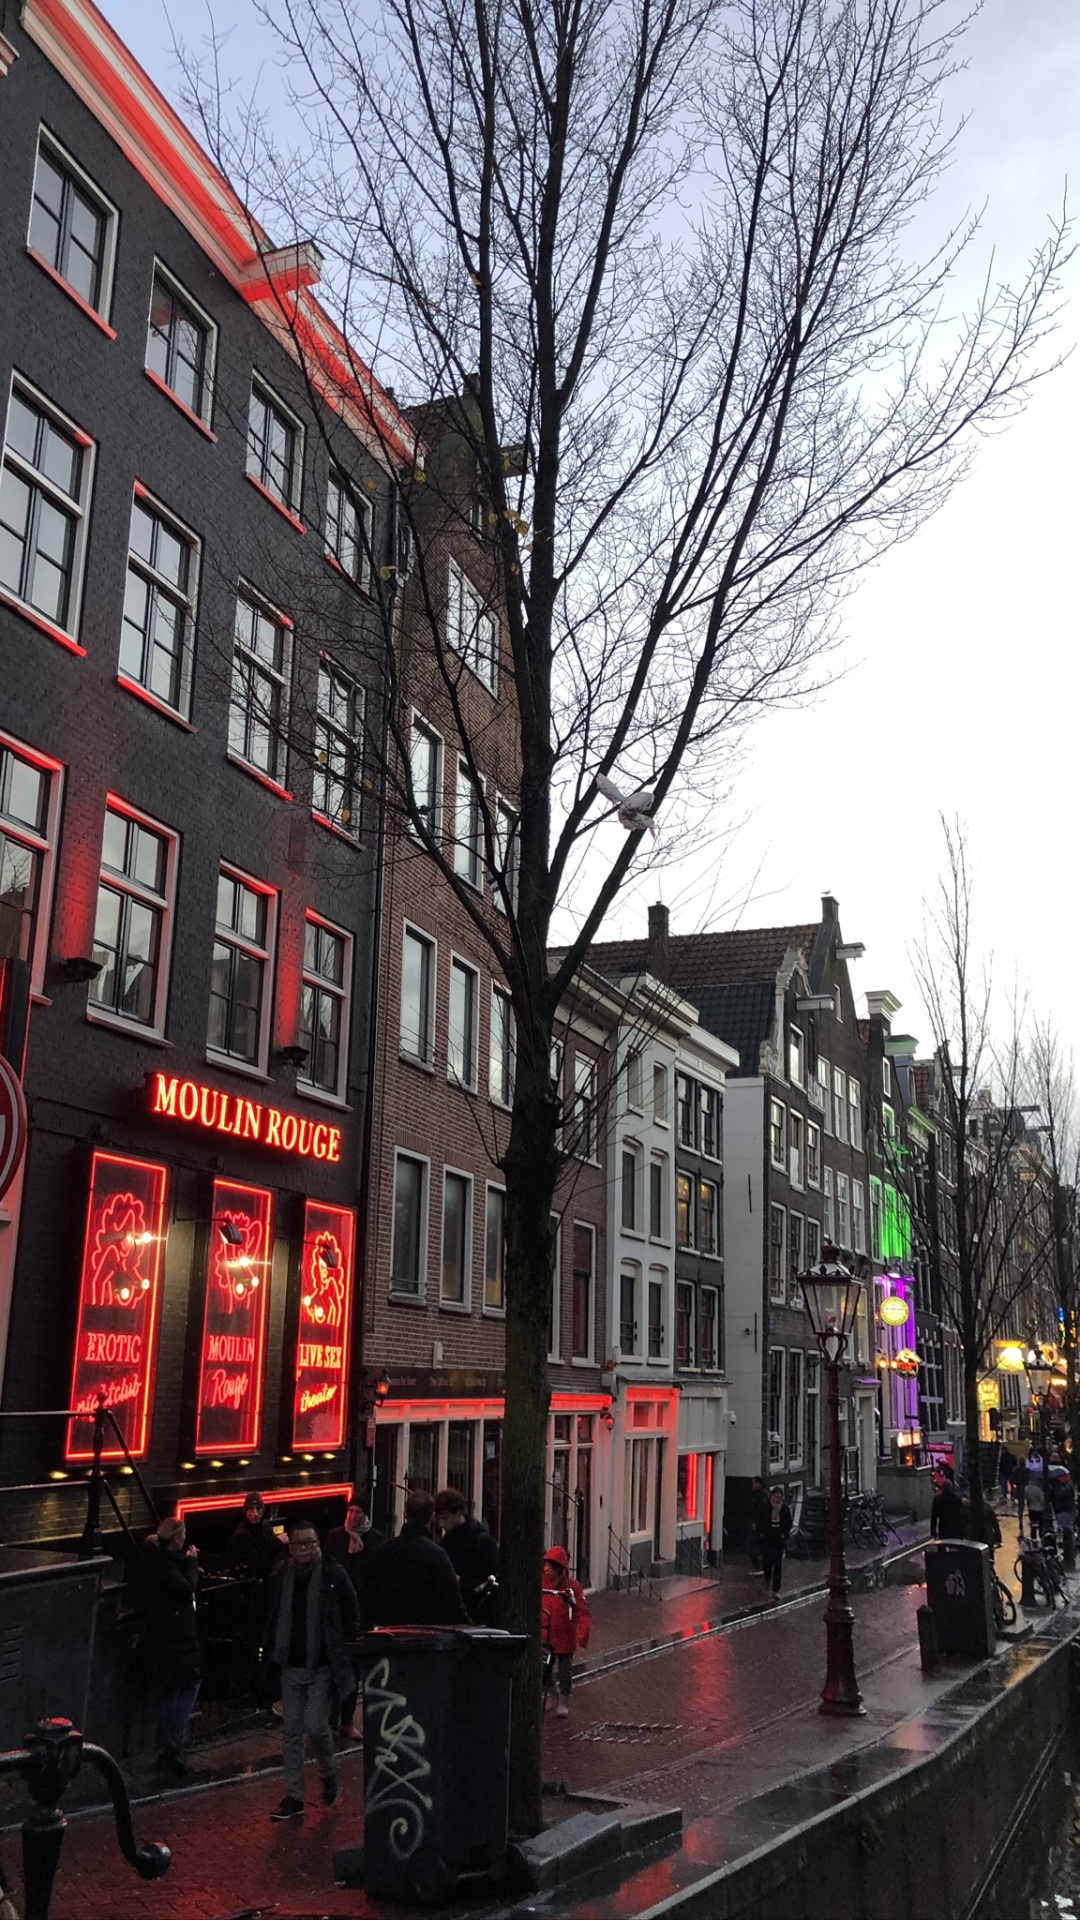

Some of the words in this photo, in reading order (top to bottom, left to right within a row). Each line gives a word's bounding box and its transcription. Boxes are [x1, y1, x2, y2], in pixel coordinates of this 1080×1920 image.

[154, 1073, 263, 1139] MOULIN
[265, 1108, 341, 1162] ROUGE
[85, 1332, 141, 1363] EROTIC
[207, 1335, 255, 1362] MOULIN
[299, 1344, 323, 1367] LIVE
[324, 1345, 342, 1368] SEX
[211, 1369, 248, 1409] Rouge
[300, 1383, 337, 1413] theater
